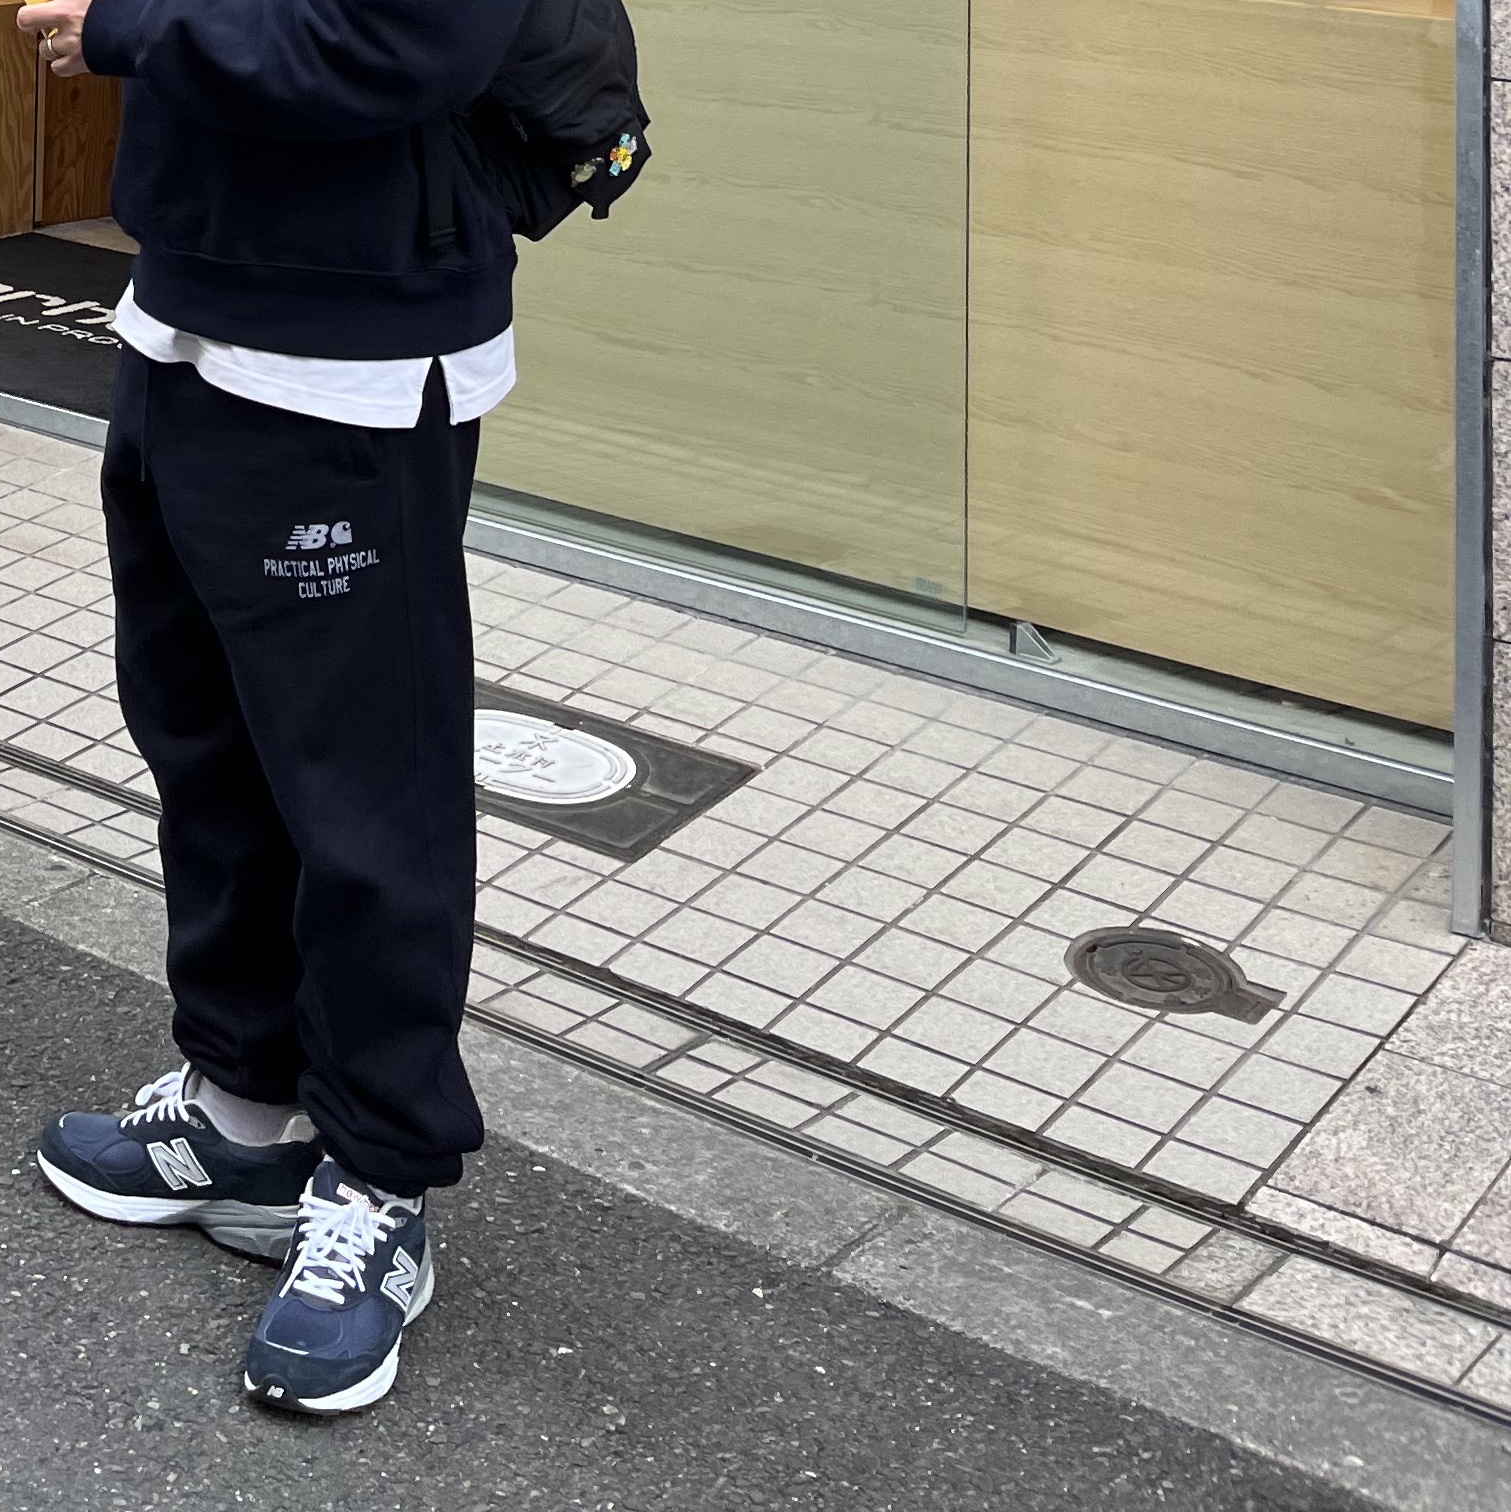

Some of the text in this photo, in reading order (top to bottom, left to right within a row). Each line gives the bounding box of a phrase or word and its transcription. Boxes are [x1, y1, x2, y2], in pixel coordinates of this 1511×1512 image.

[38, 323, 123, 349] PRO
[263, 549, 380, 578] PRACTICAL PHYSICAL
[298, 576, 351, 599] CULTURE
